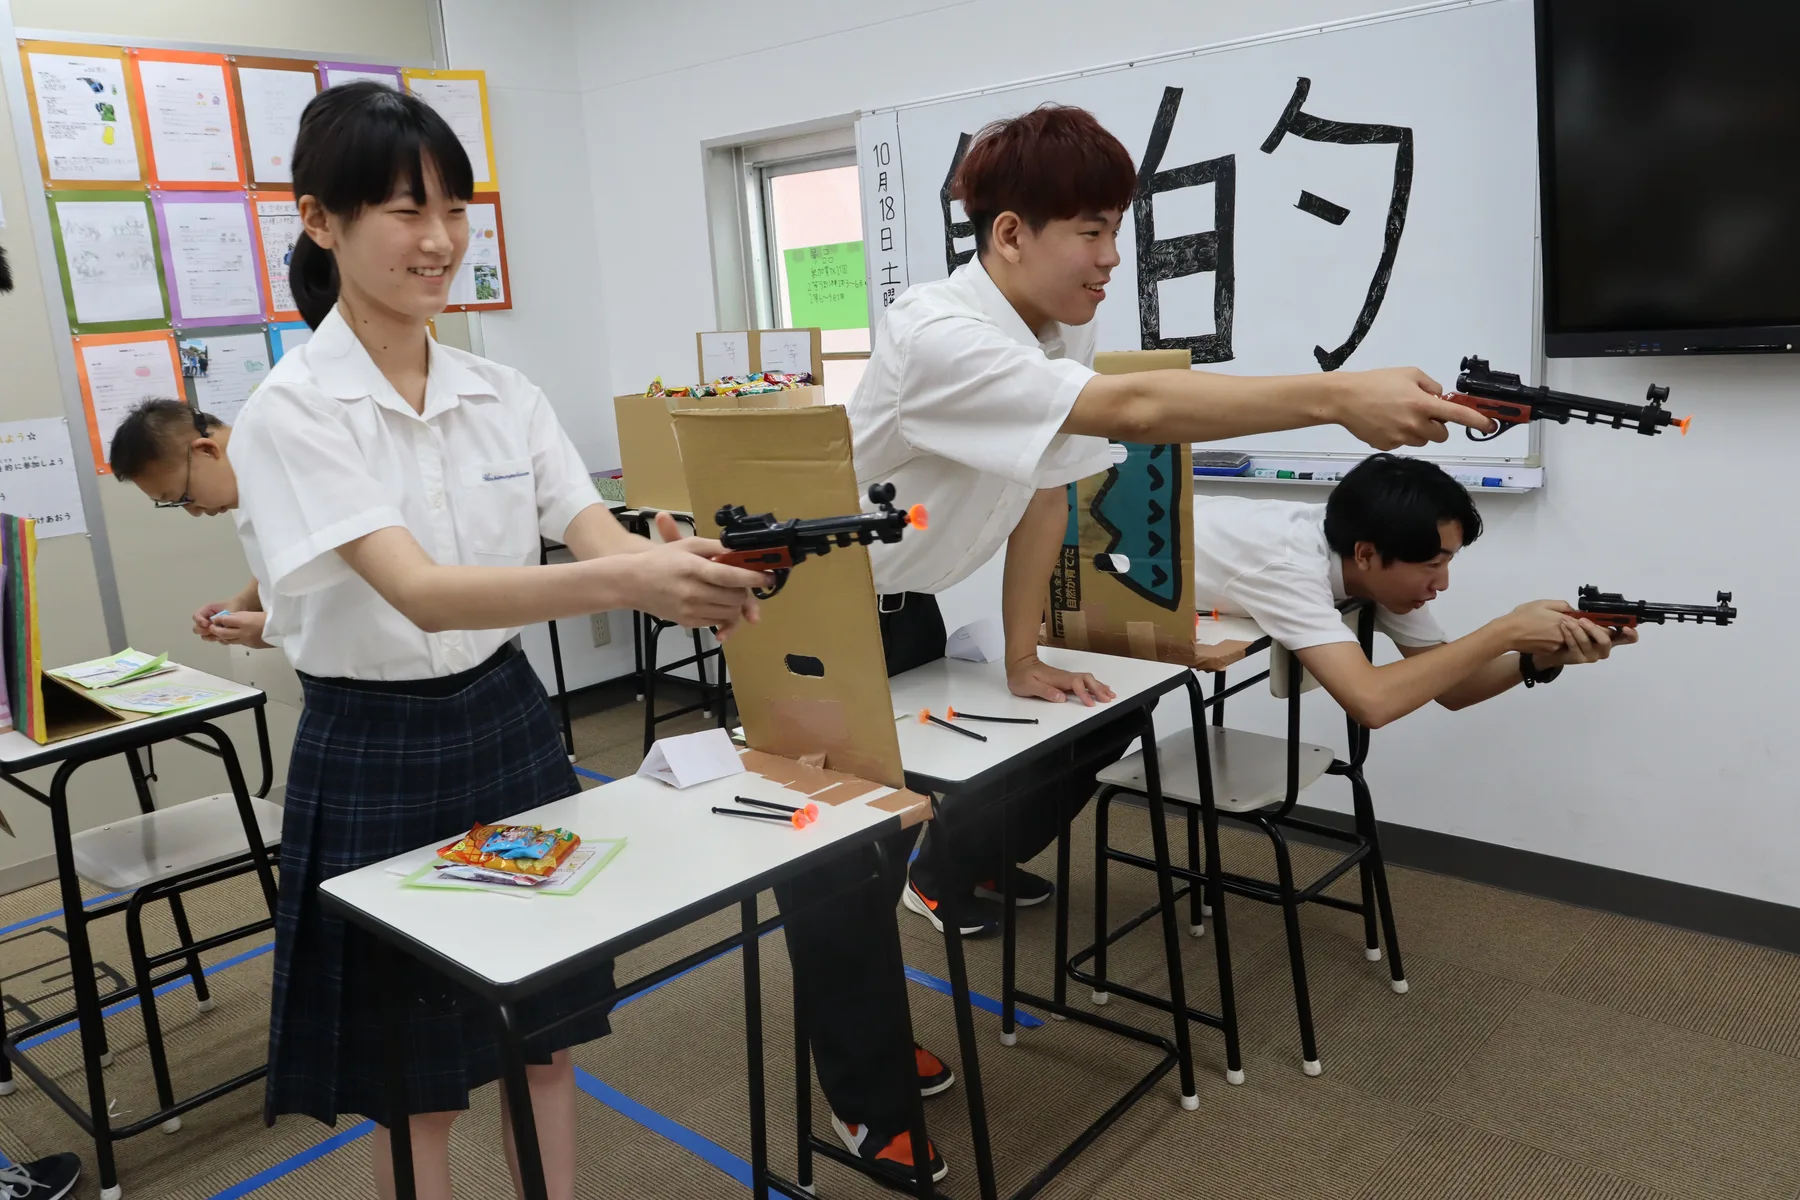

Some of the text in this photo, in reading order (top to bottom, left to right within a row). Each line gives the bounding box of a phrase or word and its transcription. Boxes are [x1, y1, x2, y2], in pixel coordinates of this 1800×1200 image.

[939, 76, 1414, 372] 的
[1064, 547, 1077, 609] 自然が育てた
